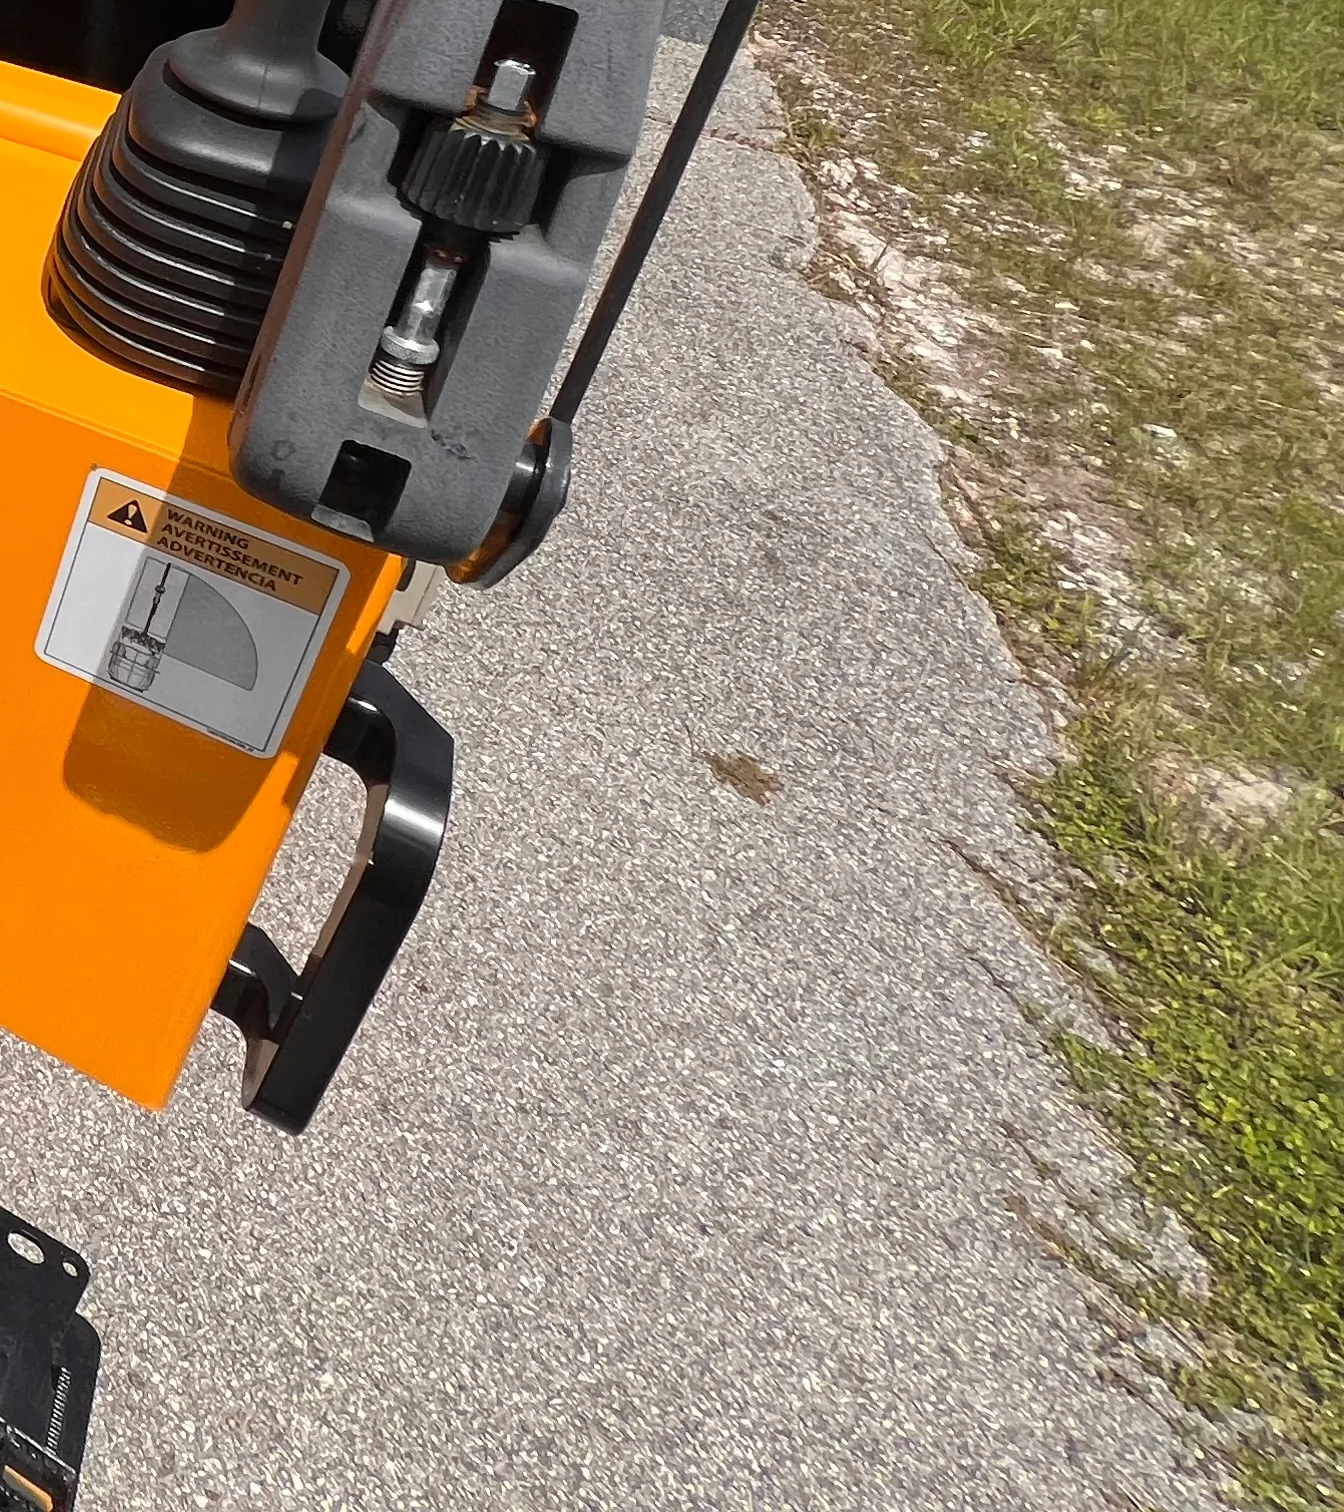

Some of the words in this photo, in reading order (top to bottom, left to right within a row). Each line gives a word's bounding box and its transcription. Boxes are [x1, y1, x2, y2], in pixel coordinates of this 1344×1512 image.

[161, 523, 303, 585] AVERTISSEMENT
[167, 509, 249, 550] WARNING
[156, 536, 276, 591] ADVERTENCIA
